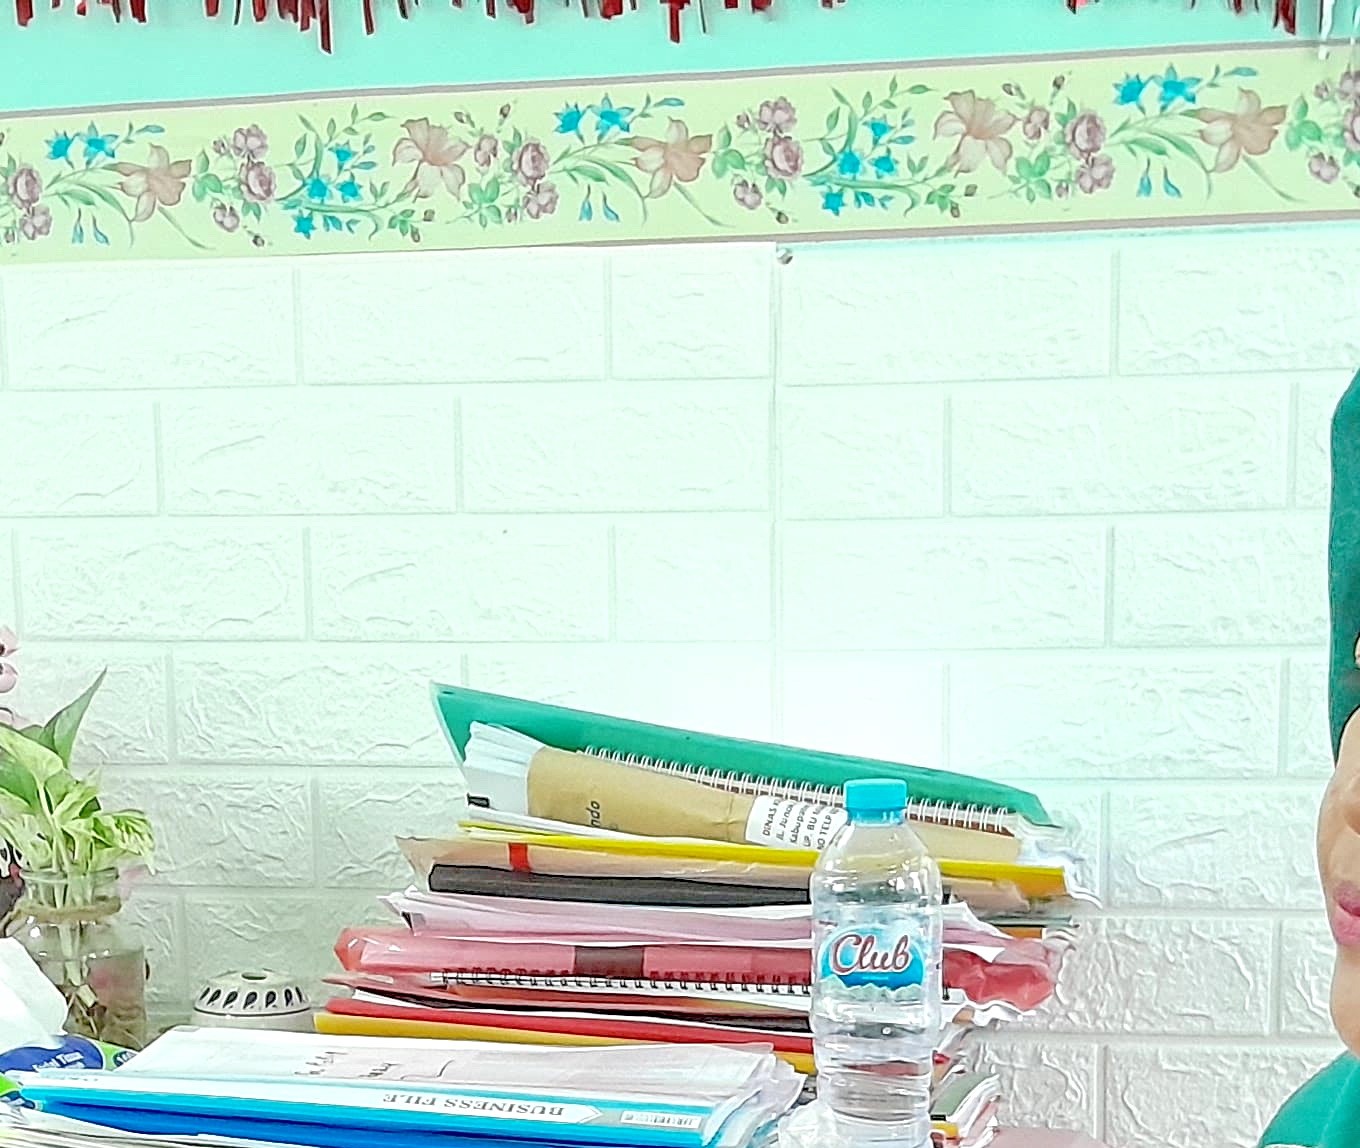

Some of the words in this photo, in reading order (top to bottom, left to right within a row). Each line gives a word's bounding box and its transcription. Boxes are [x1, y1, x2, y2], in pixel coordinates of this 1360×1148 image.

[832, 932, 911, 973] Club
[382, 1093, 437, 1107] FILE
[444, 1099, 566, 1117] BUSINESS
